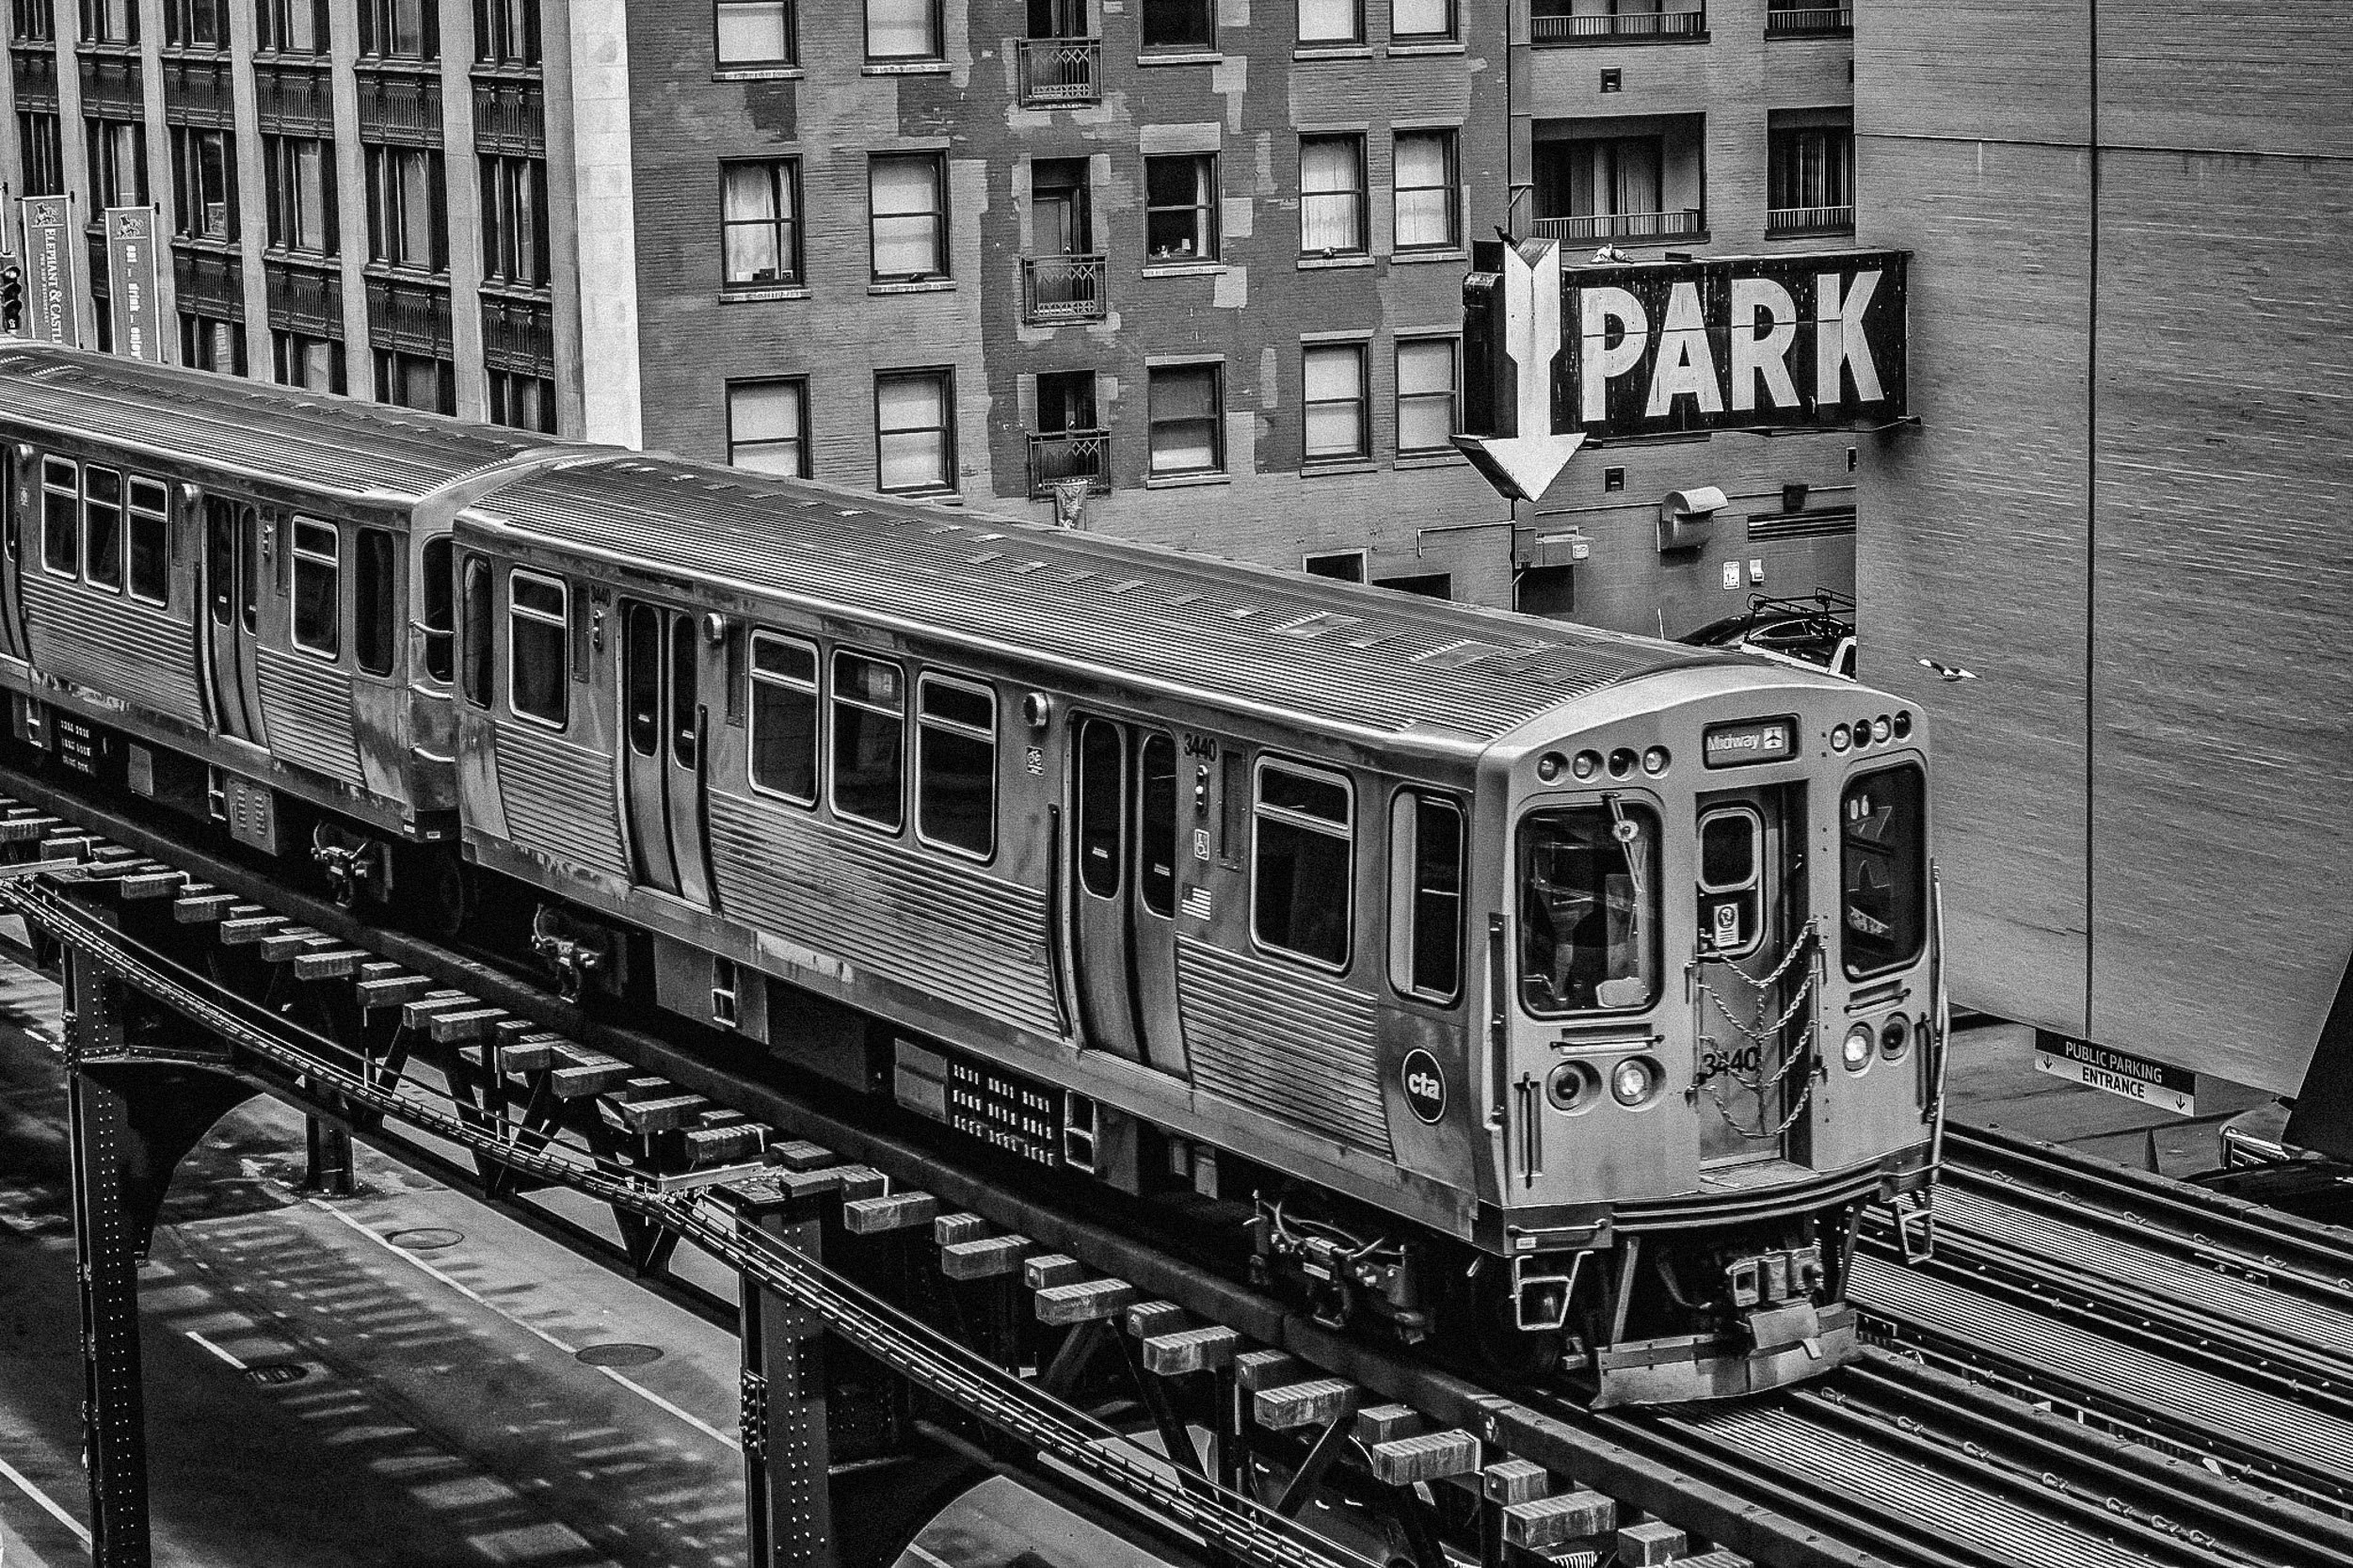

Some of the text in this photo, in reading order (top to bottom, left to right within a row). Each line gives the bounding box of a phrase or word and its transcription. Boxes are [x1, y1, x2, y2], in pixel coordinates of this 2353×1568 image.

[44, 228, 58, 288] ELEPHANT
[48, 289, 63, 303] &
[128, 282, 140, 312] drink
[1581, 270, 1884, 422] PARK
[1184, 732, 1218, 762] 3440
[1706, 733, 1760, 751] Midway
[2065, 1041, 2163, 1083] PUBLIC PARKING
[1408, 1072, 1441, 1100] cta
[2082, 1065, 2145, 1099] ENTRANCE
